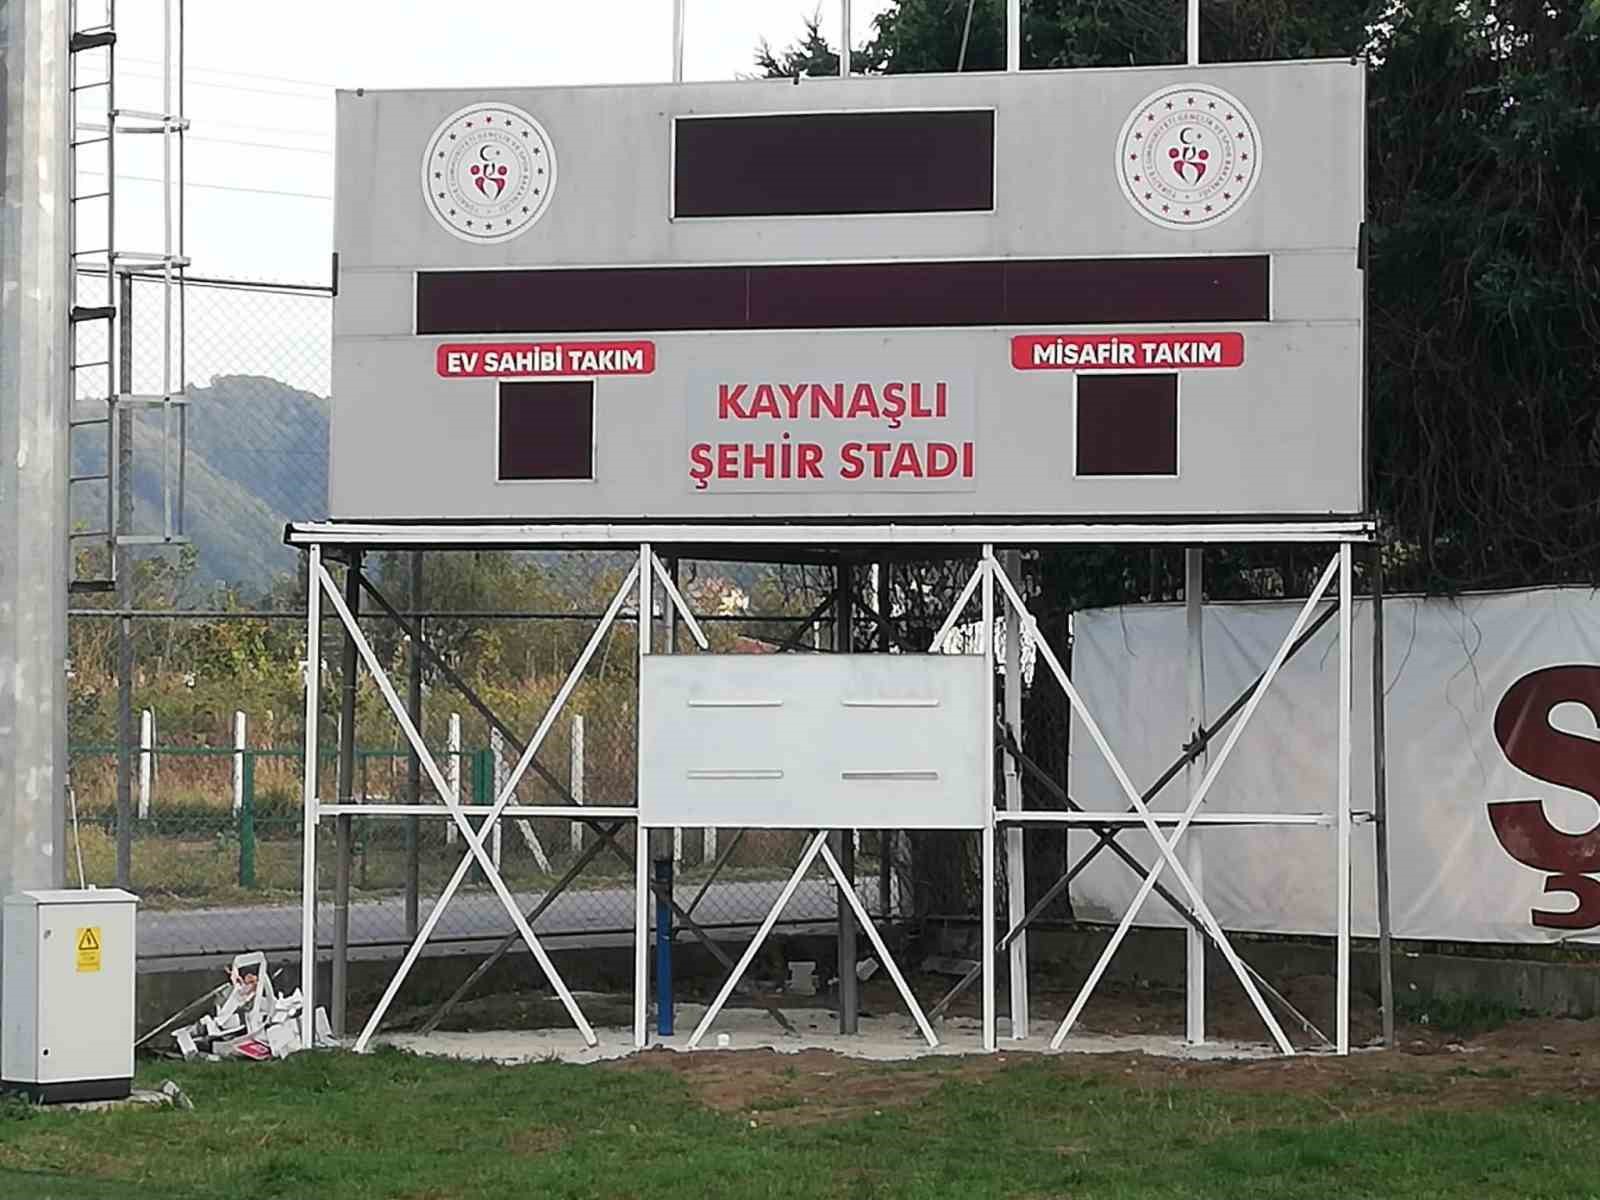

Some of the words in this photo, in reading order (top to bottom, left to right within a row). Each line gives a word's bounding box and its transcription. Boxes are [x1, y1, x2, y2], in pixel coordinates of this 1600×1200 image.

[447, 351, 479, 373] EV
[484, 345, 563, 372] SAHİBİ
[568, 349, 644, 370] TAKIM
[1033, 337, 1136, 365] MİSAFİR
[1142, 341, 1222, 364] TAKIM
[718, 382, 947, 429] KAYNAŞLI
[689, 432, 824, 490] ŞEHİR
[839, 441, 974, 478] STADI
